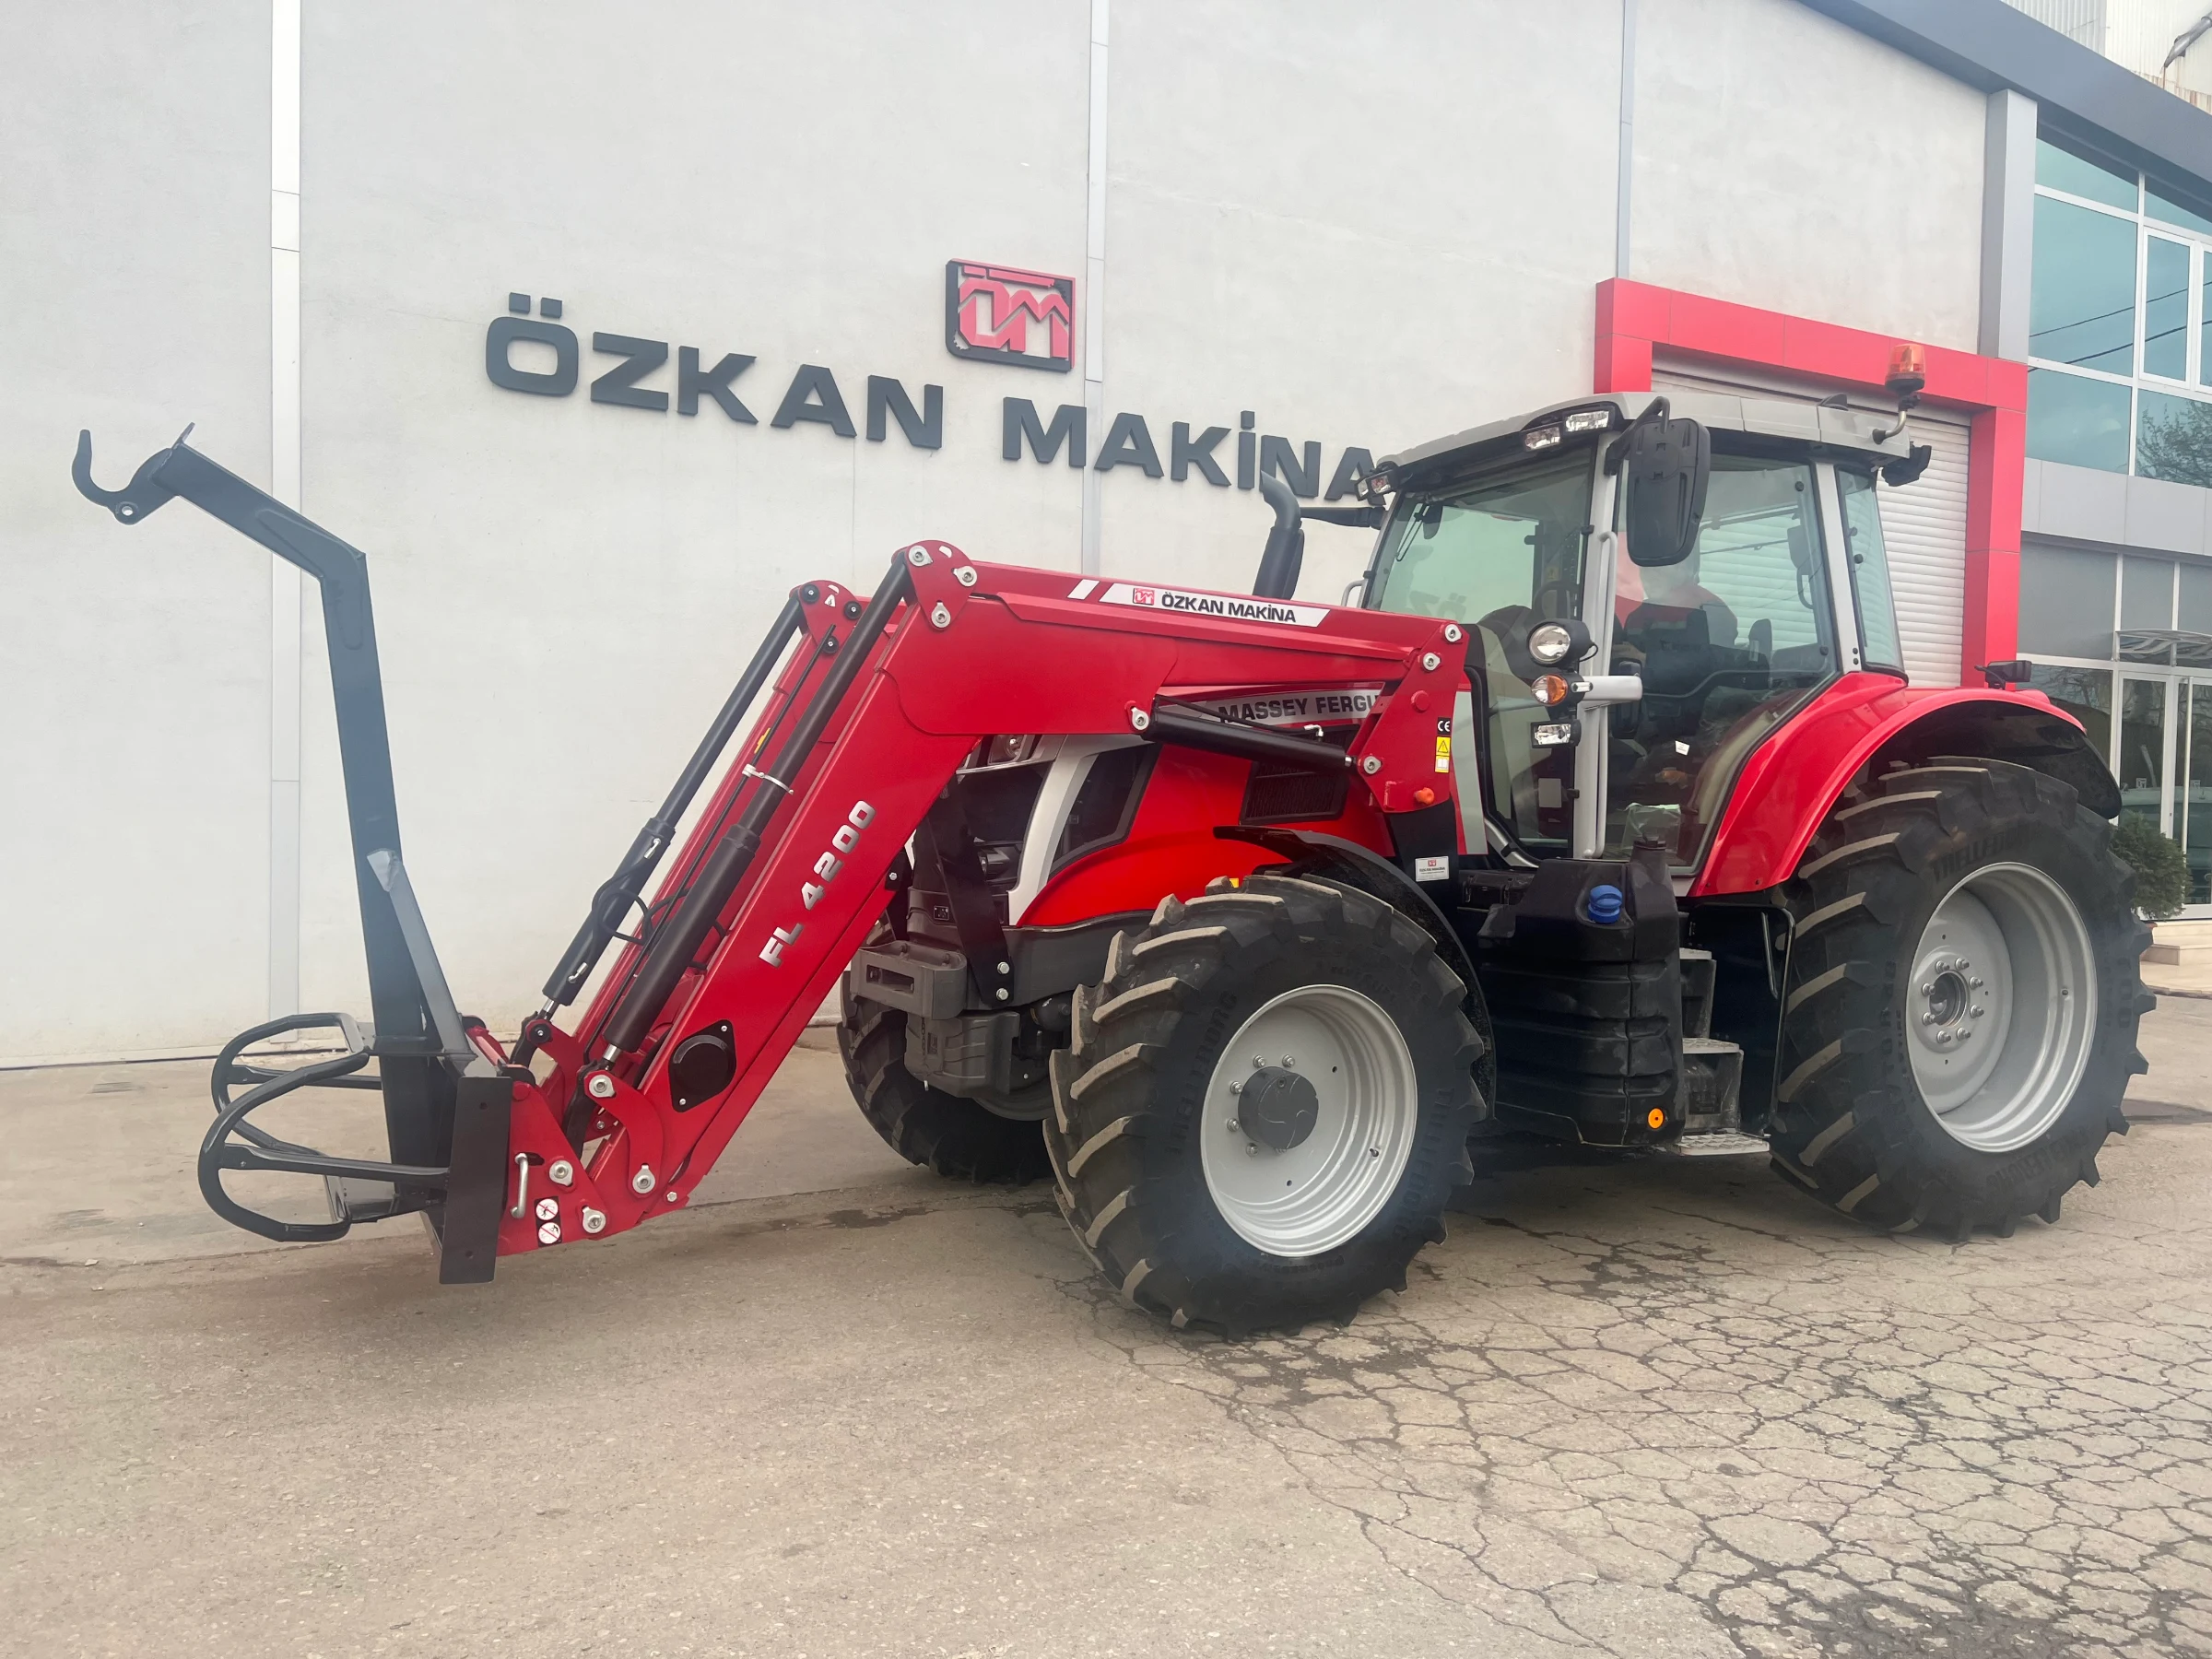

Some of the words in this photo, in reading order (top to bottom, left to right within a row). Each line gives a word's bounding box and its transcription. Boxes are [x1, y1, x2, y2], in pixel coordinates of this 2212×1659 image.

[486, 291, 943, 450] ÖZKAN
[1002, 396, 1387, 506] MAKİNA
[1161, 591, 1224, 615] ÖZKAN
[1228, 602, 1297, 623] MAKİNA
[1218, 698, 1308, 721] MASSEY
[759, 922, 805, 968] FL
[801, 799, 877, 912] 4200
